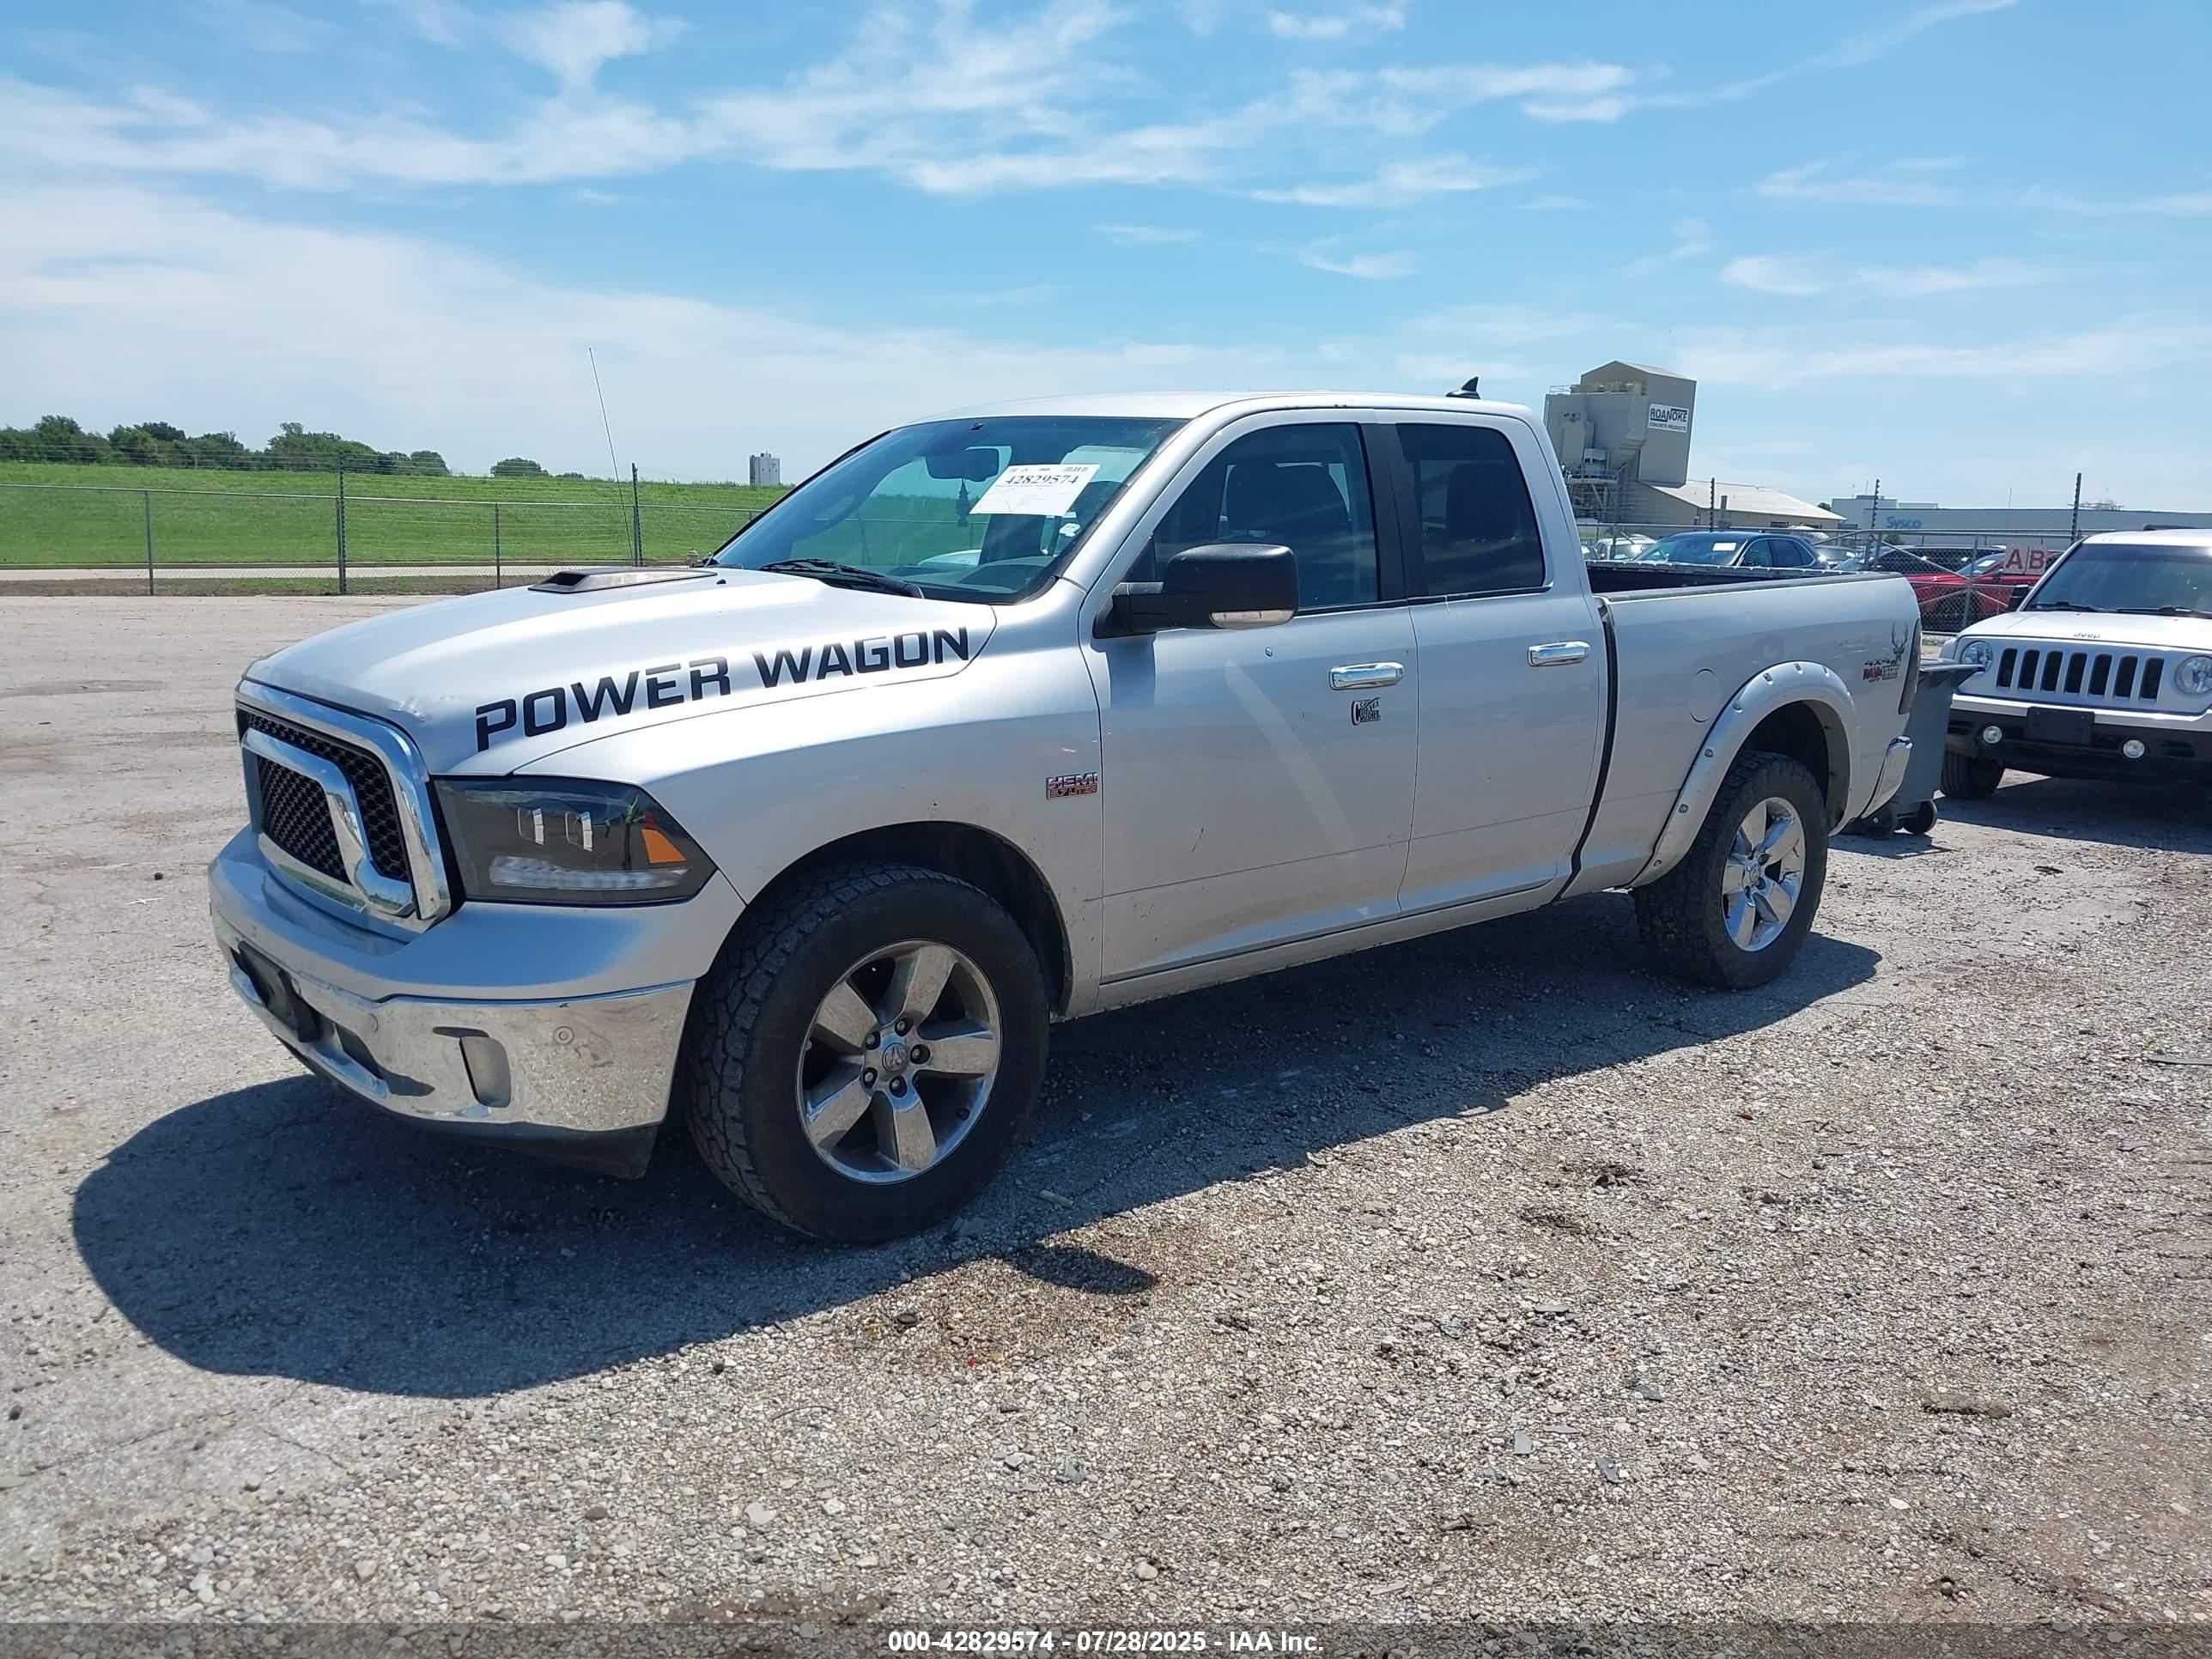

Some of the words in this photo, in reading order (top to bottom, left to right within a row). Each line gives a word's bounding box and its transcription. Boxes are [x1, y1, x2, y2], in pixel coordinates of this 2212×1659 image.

[1650, 408, 1688, 422] ROANOKE
[1005, 474, 1079, 484] 42829574
[1886, 516, 1923, 530] Sysco
[2004, 548, 2023, 570] A
[2028, 550, 2045, 570] B
[475, 655, 731, 752] POWER
[751, 626, 969, 689] WAGON
[1046, 772, 1098, 790] HEMI
